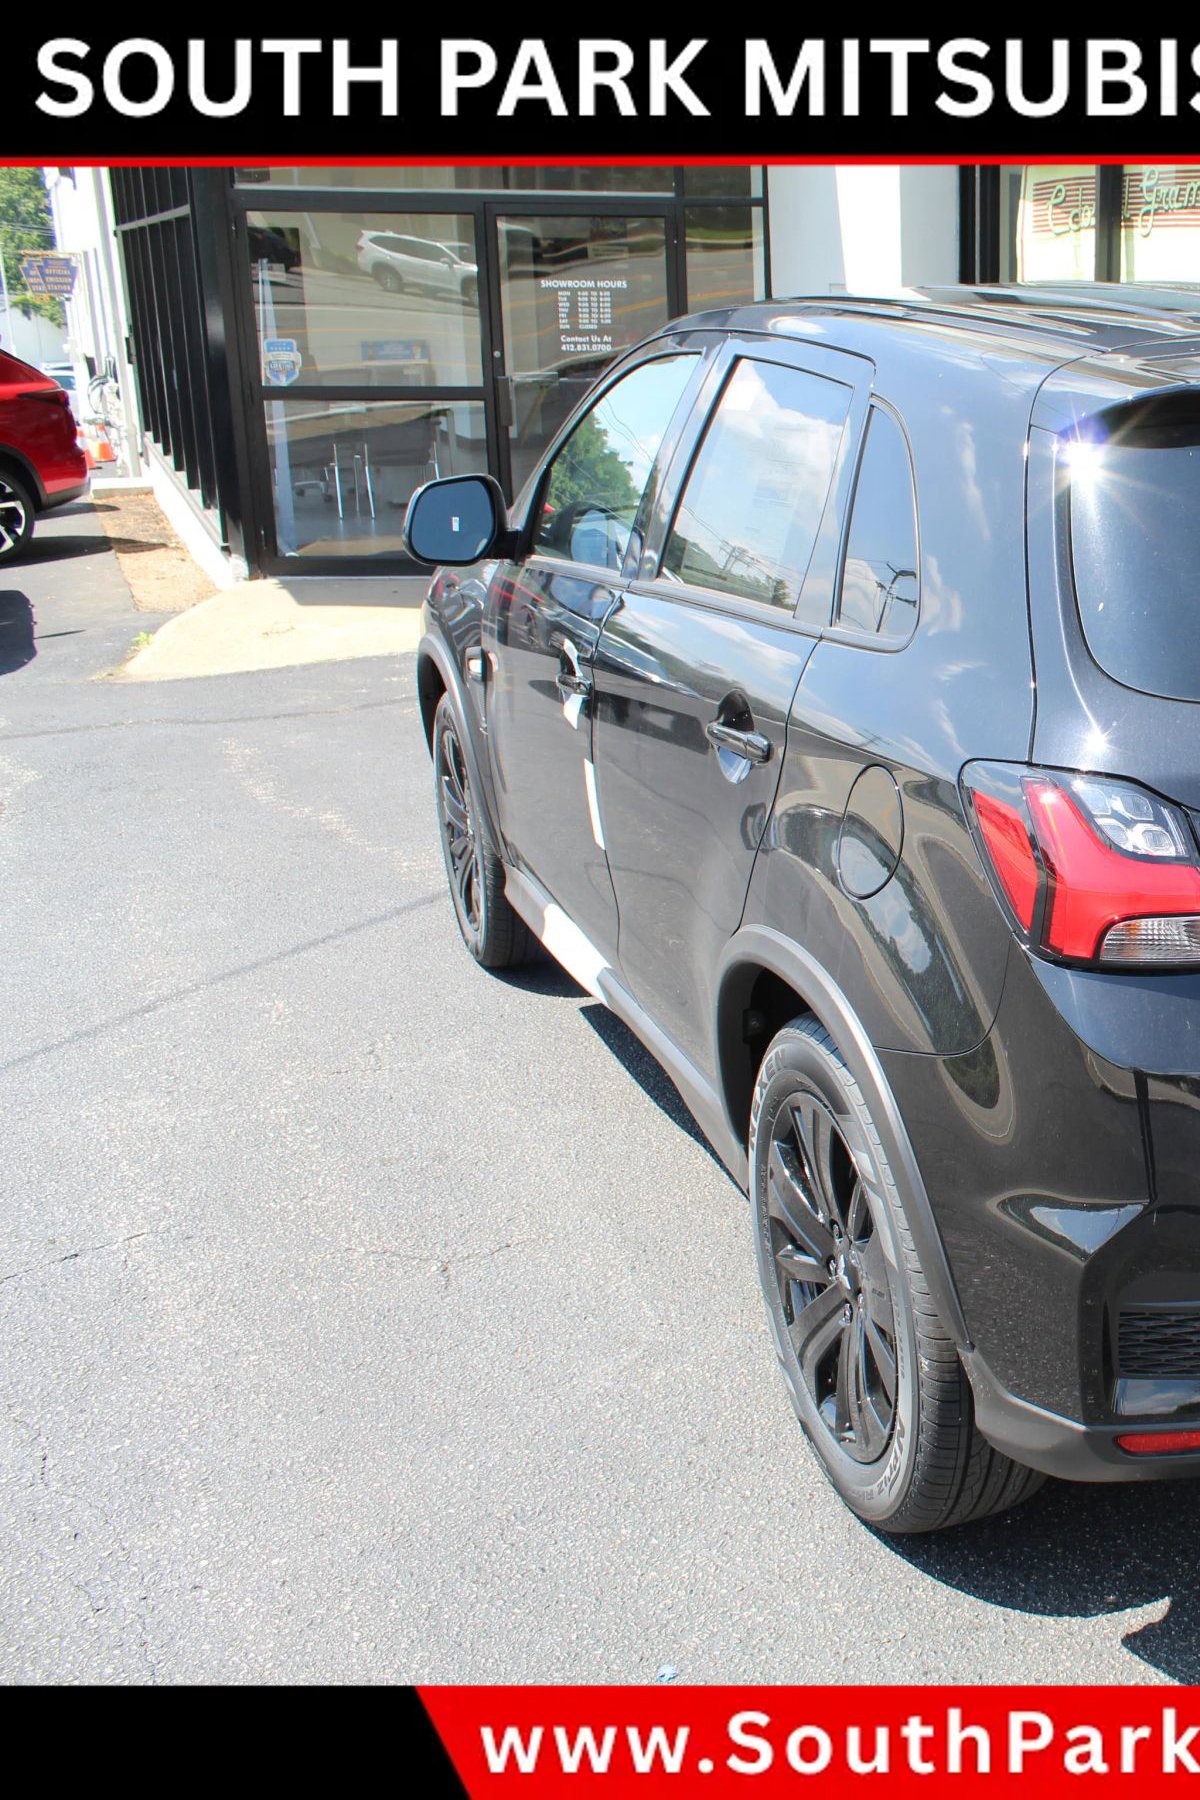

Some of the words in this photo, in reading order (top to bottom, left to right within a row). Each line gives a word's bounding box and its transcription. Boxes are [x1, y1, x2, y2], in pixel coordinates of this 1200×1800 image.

[541, 280, 595, 288] SHOWROOM
[597, 280, 627, 288] HOURS
[749, 1047, 785, 1151] NEXEN
